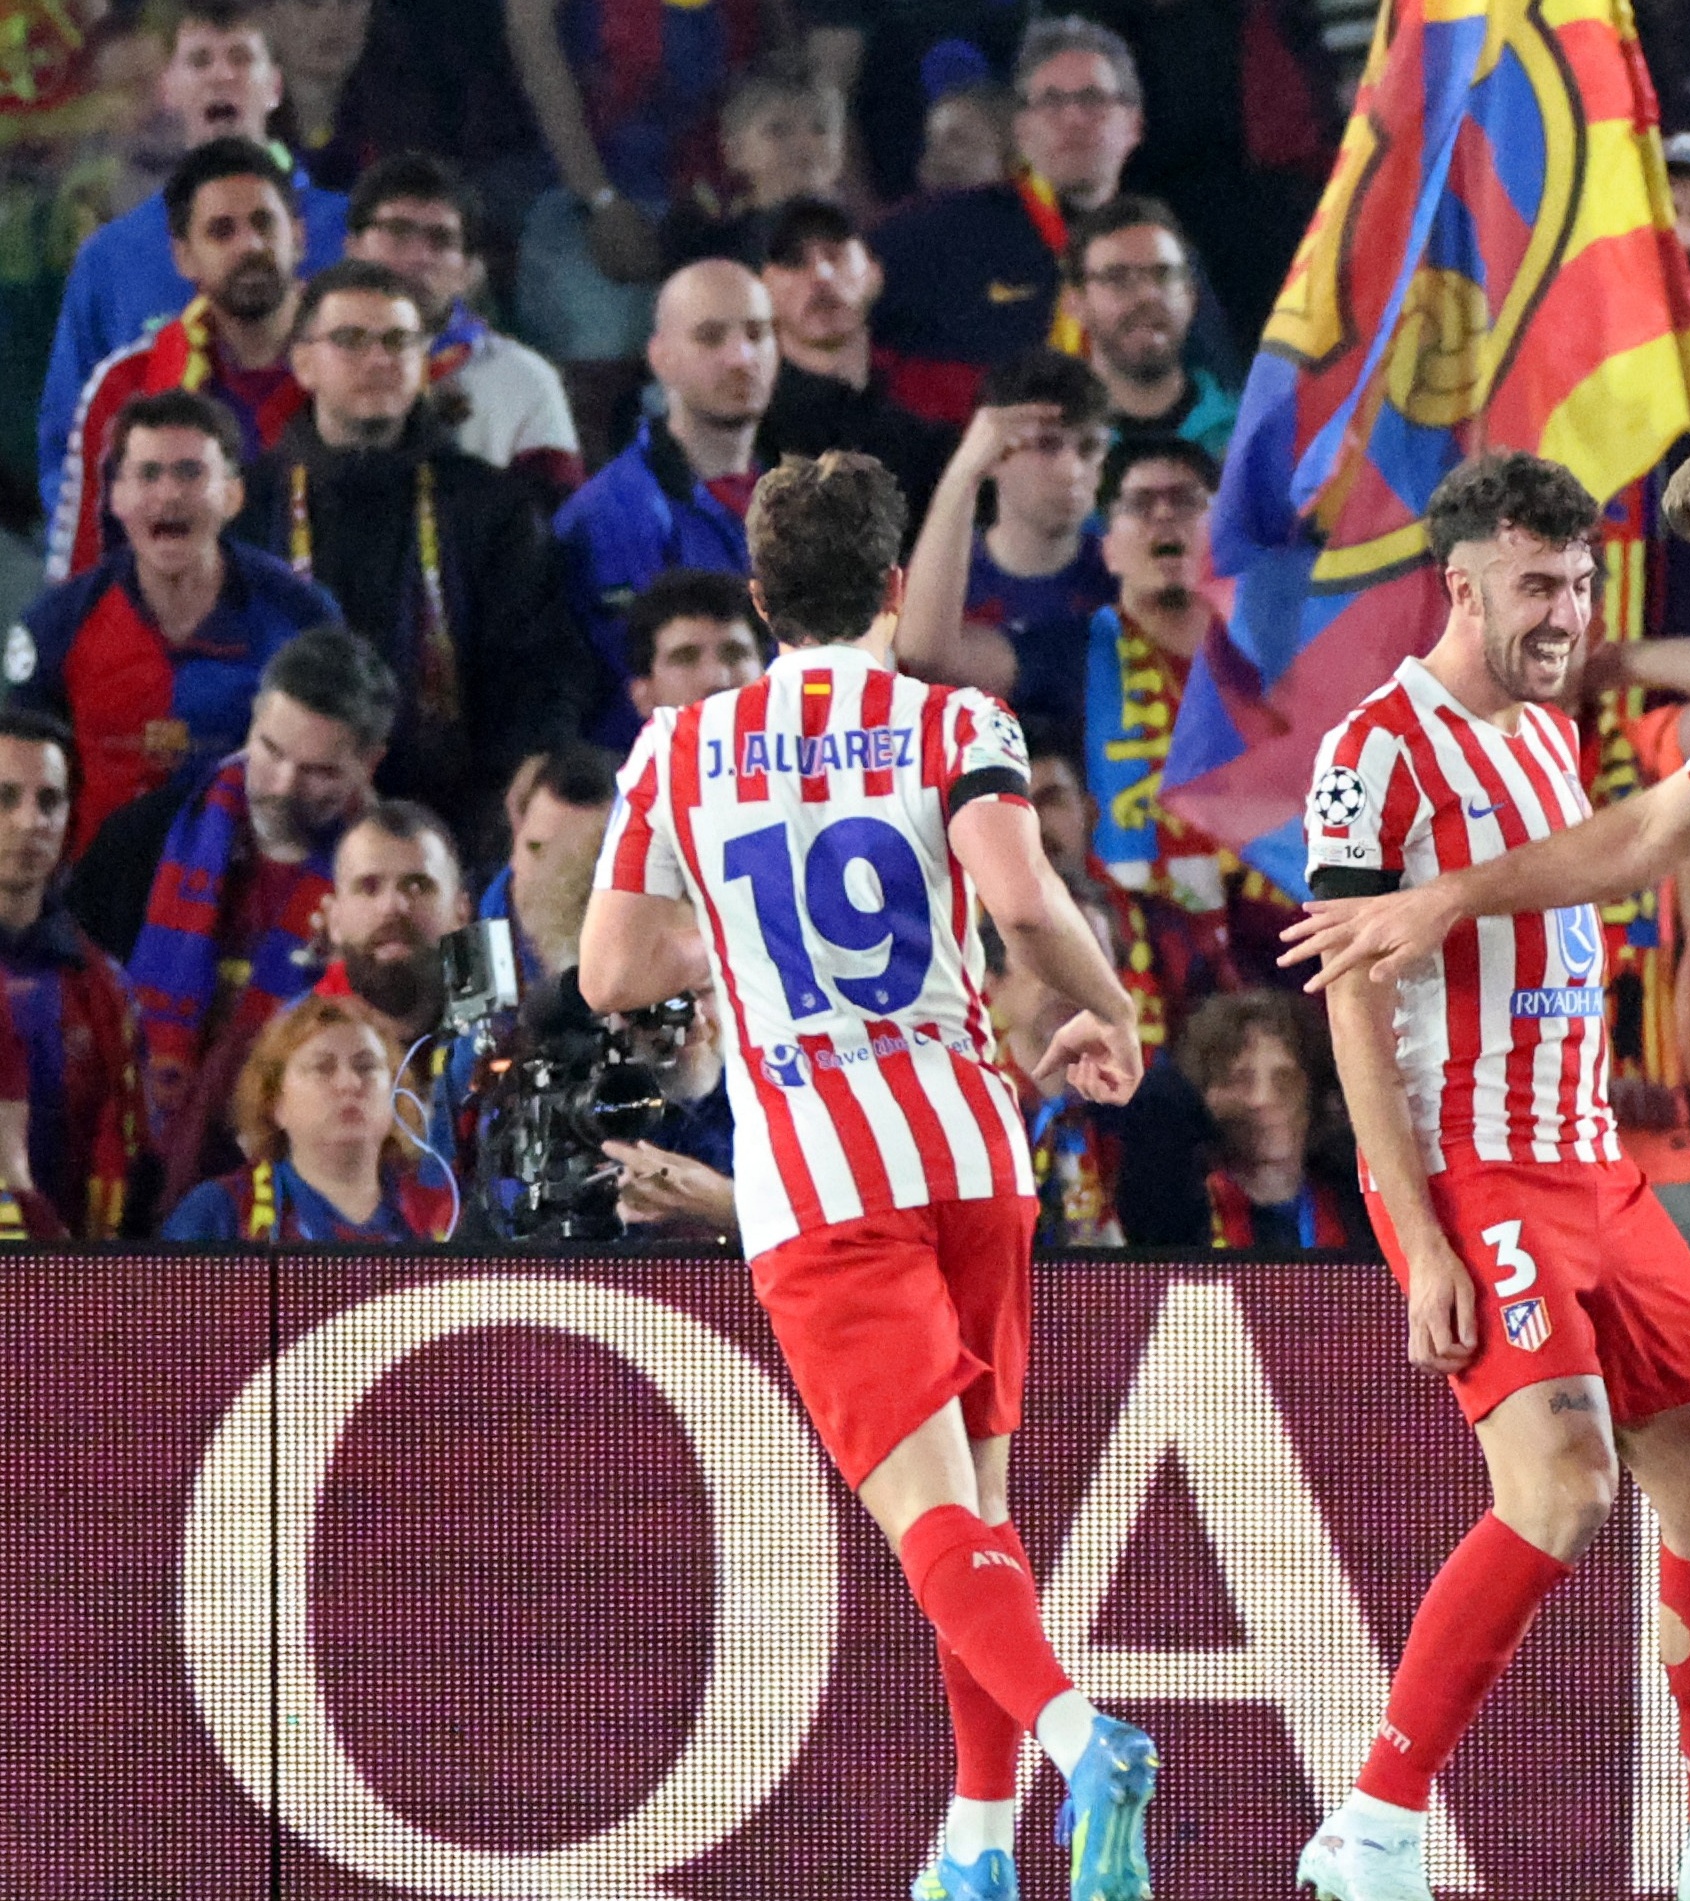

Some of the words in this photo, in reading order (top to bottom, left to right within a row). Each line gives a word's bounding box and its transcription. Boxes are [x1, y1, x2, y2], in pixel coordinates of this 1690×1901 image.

[723, 816, 933, 1020] 19
[1516, 990, 1590, 1015] RIYADH
[1481, 1219, 1537, 1298] 3
